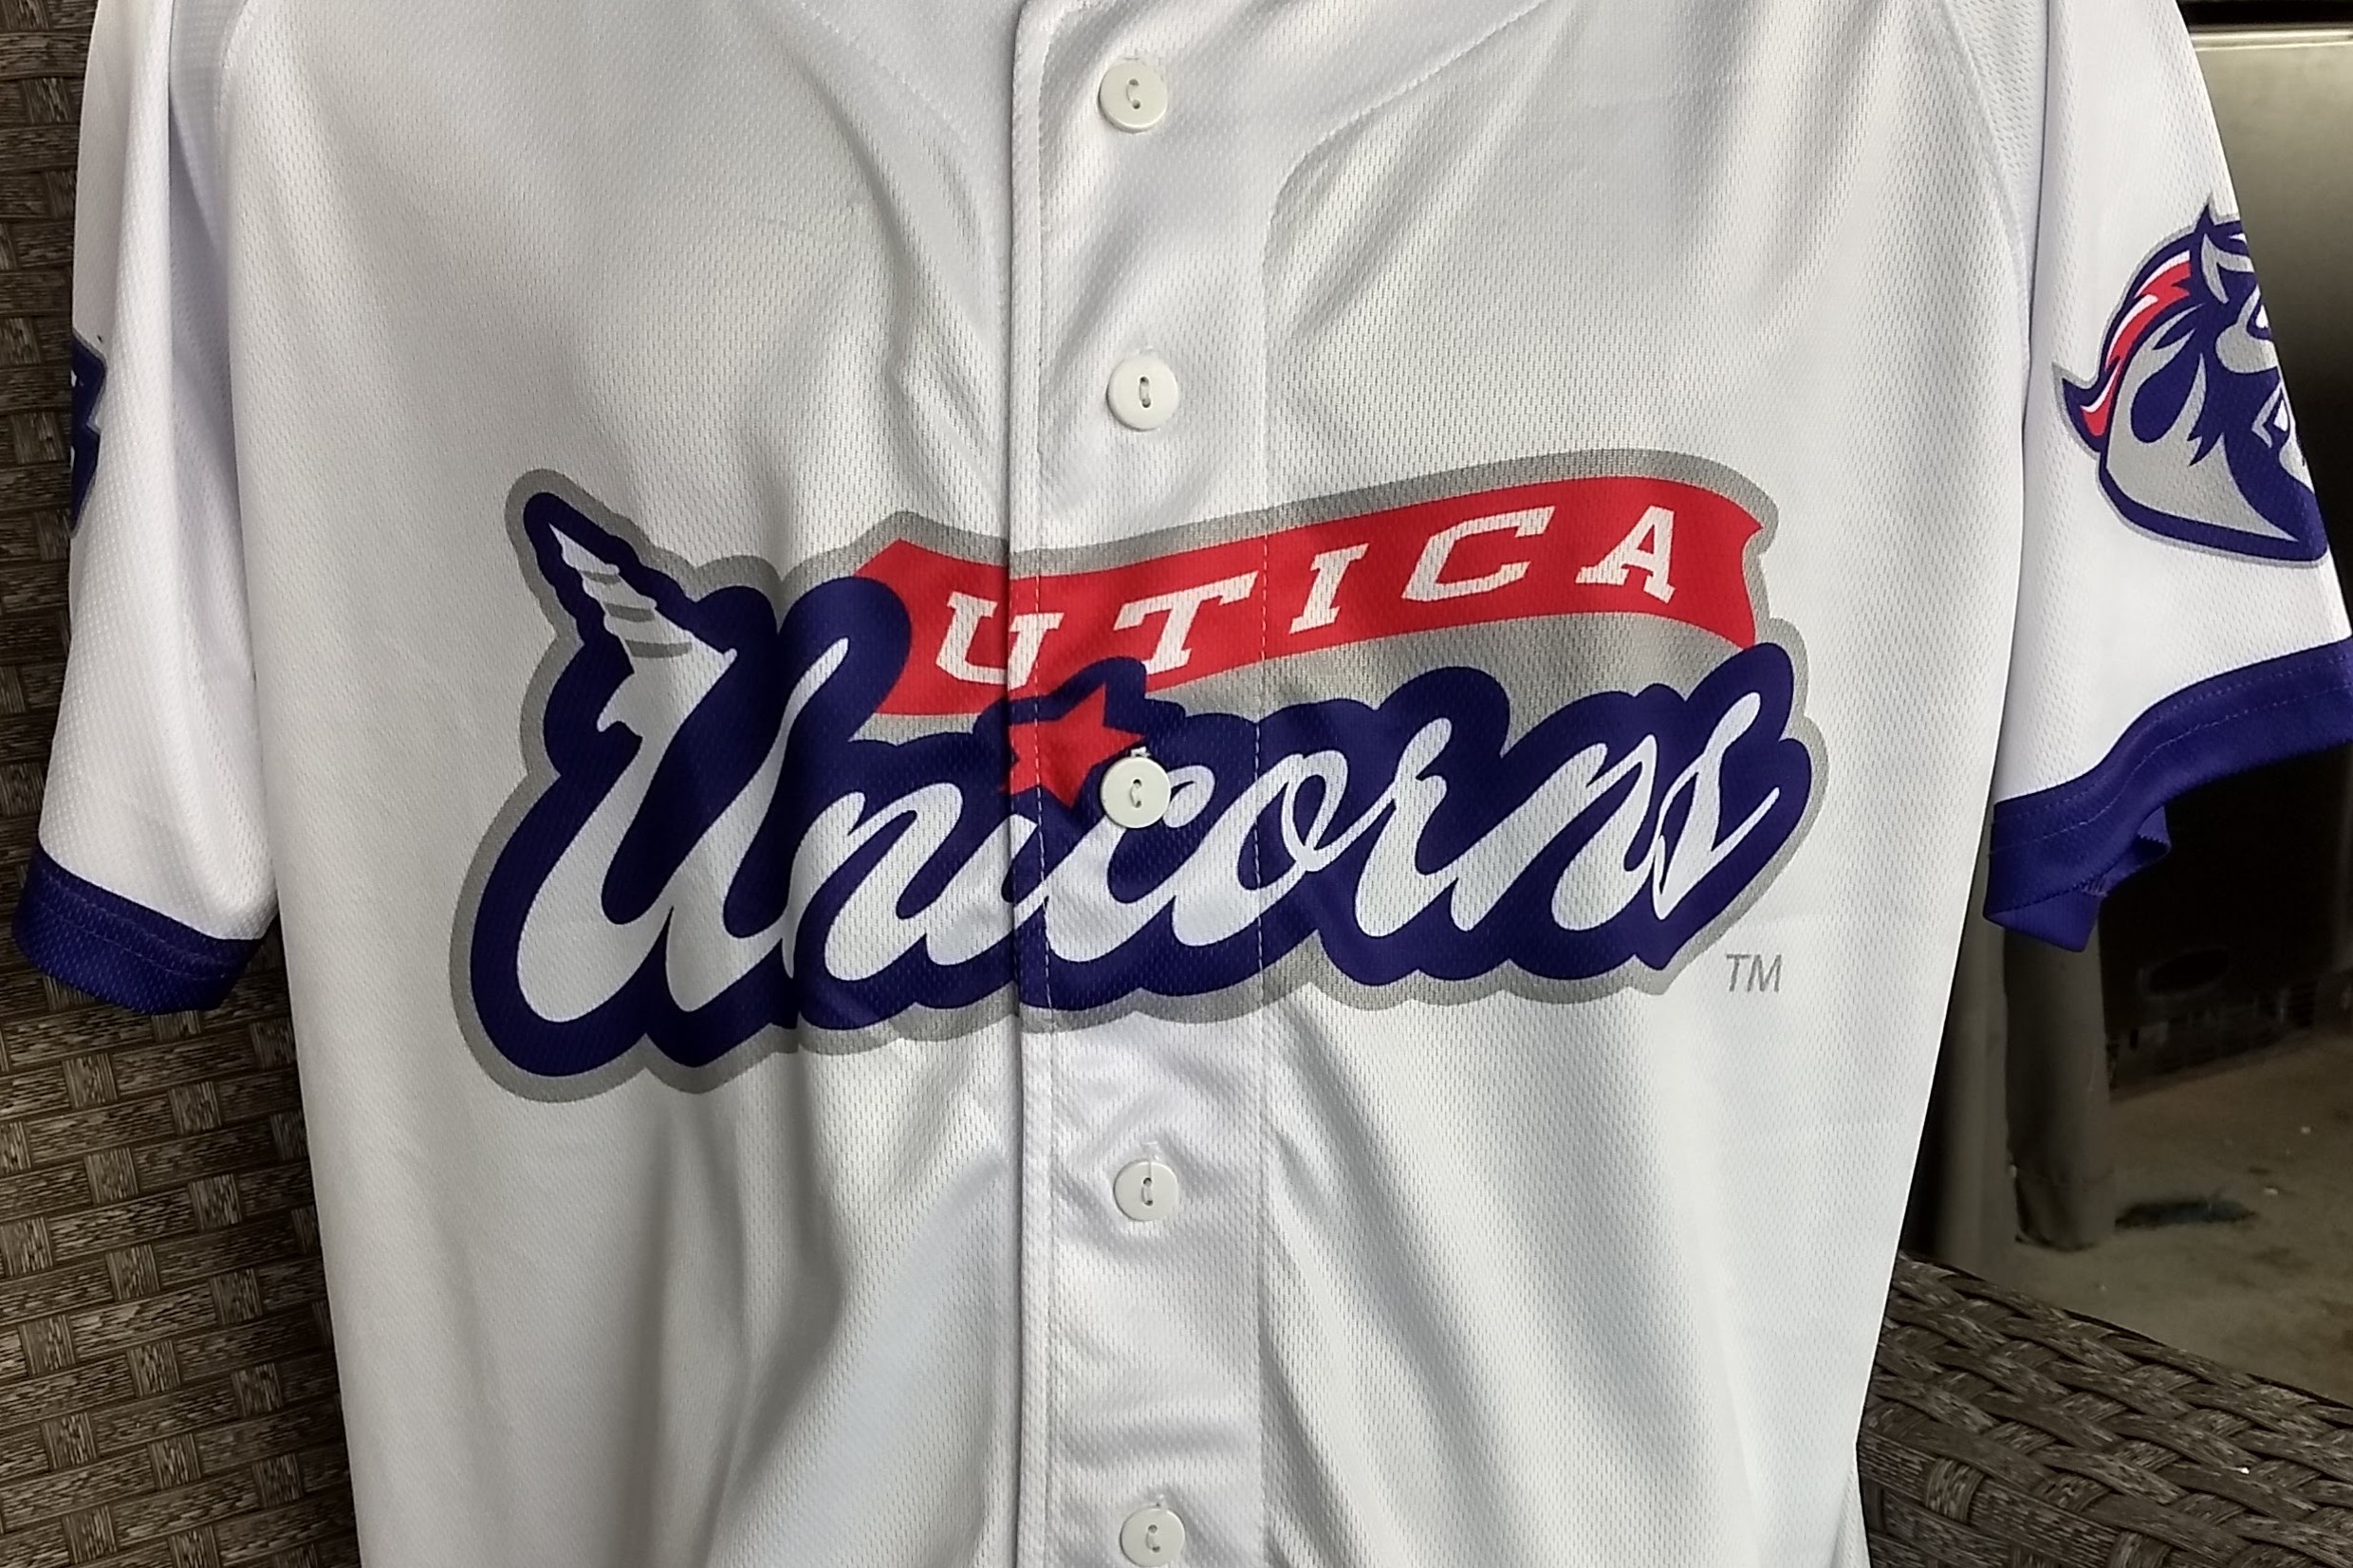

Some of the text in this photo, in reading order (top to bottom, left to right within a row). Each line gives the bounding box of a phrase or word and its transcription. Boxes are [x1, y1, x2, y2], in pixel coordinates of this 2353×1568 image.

[935, 505, 1677, 690] UTICA
[516, 523, 1780, 1023] Unicorns
[1725, 952, 1782, 993] TM
